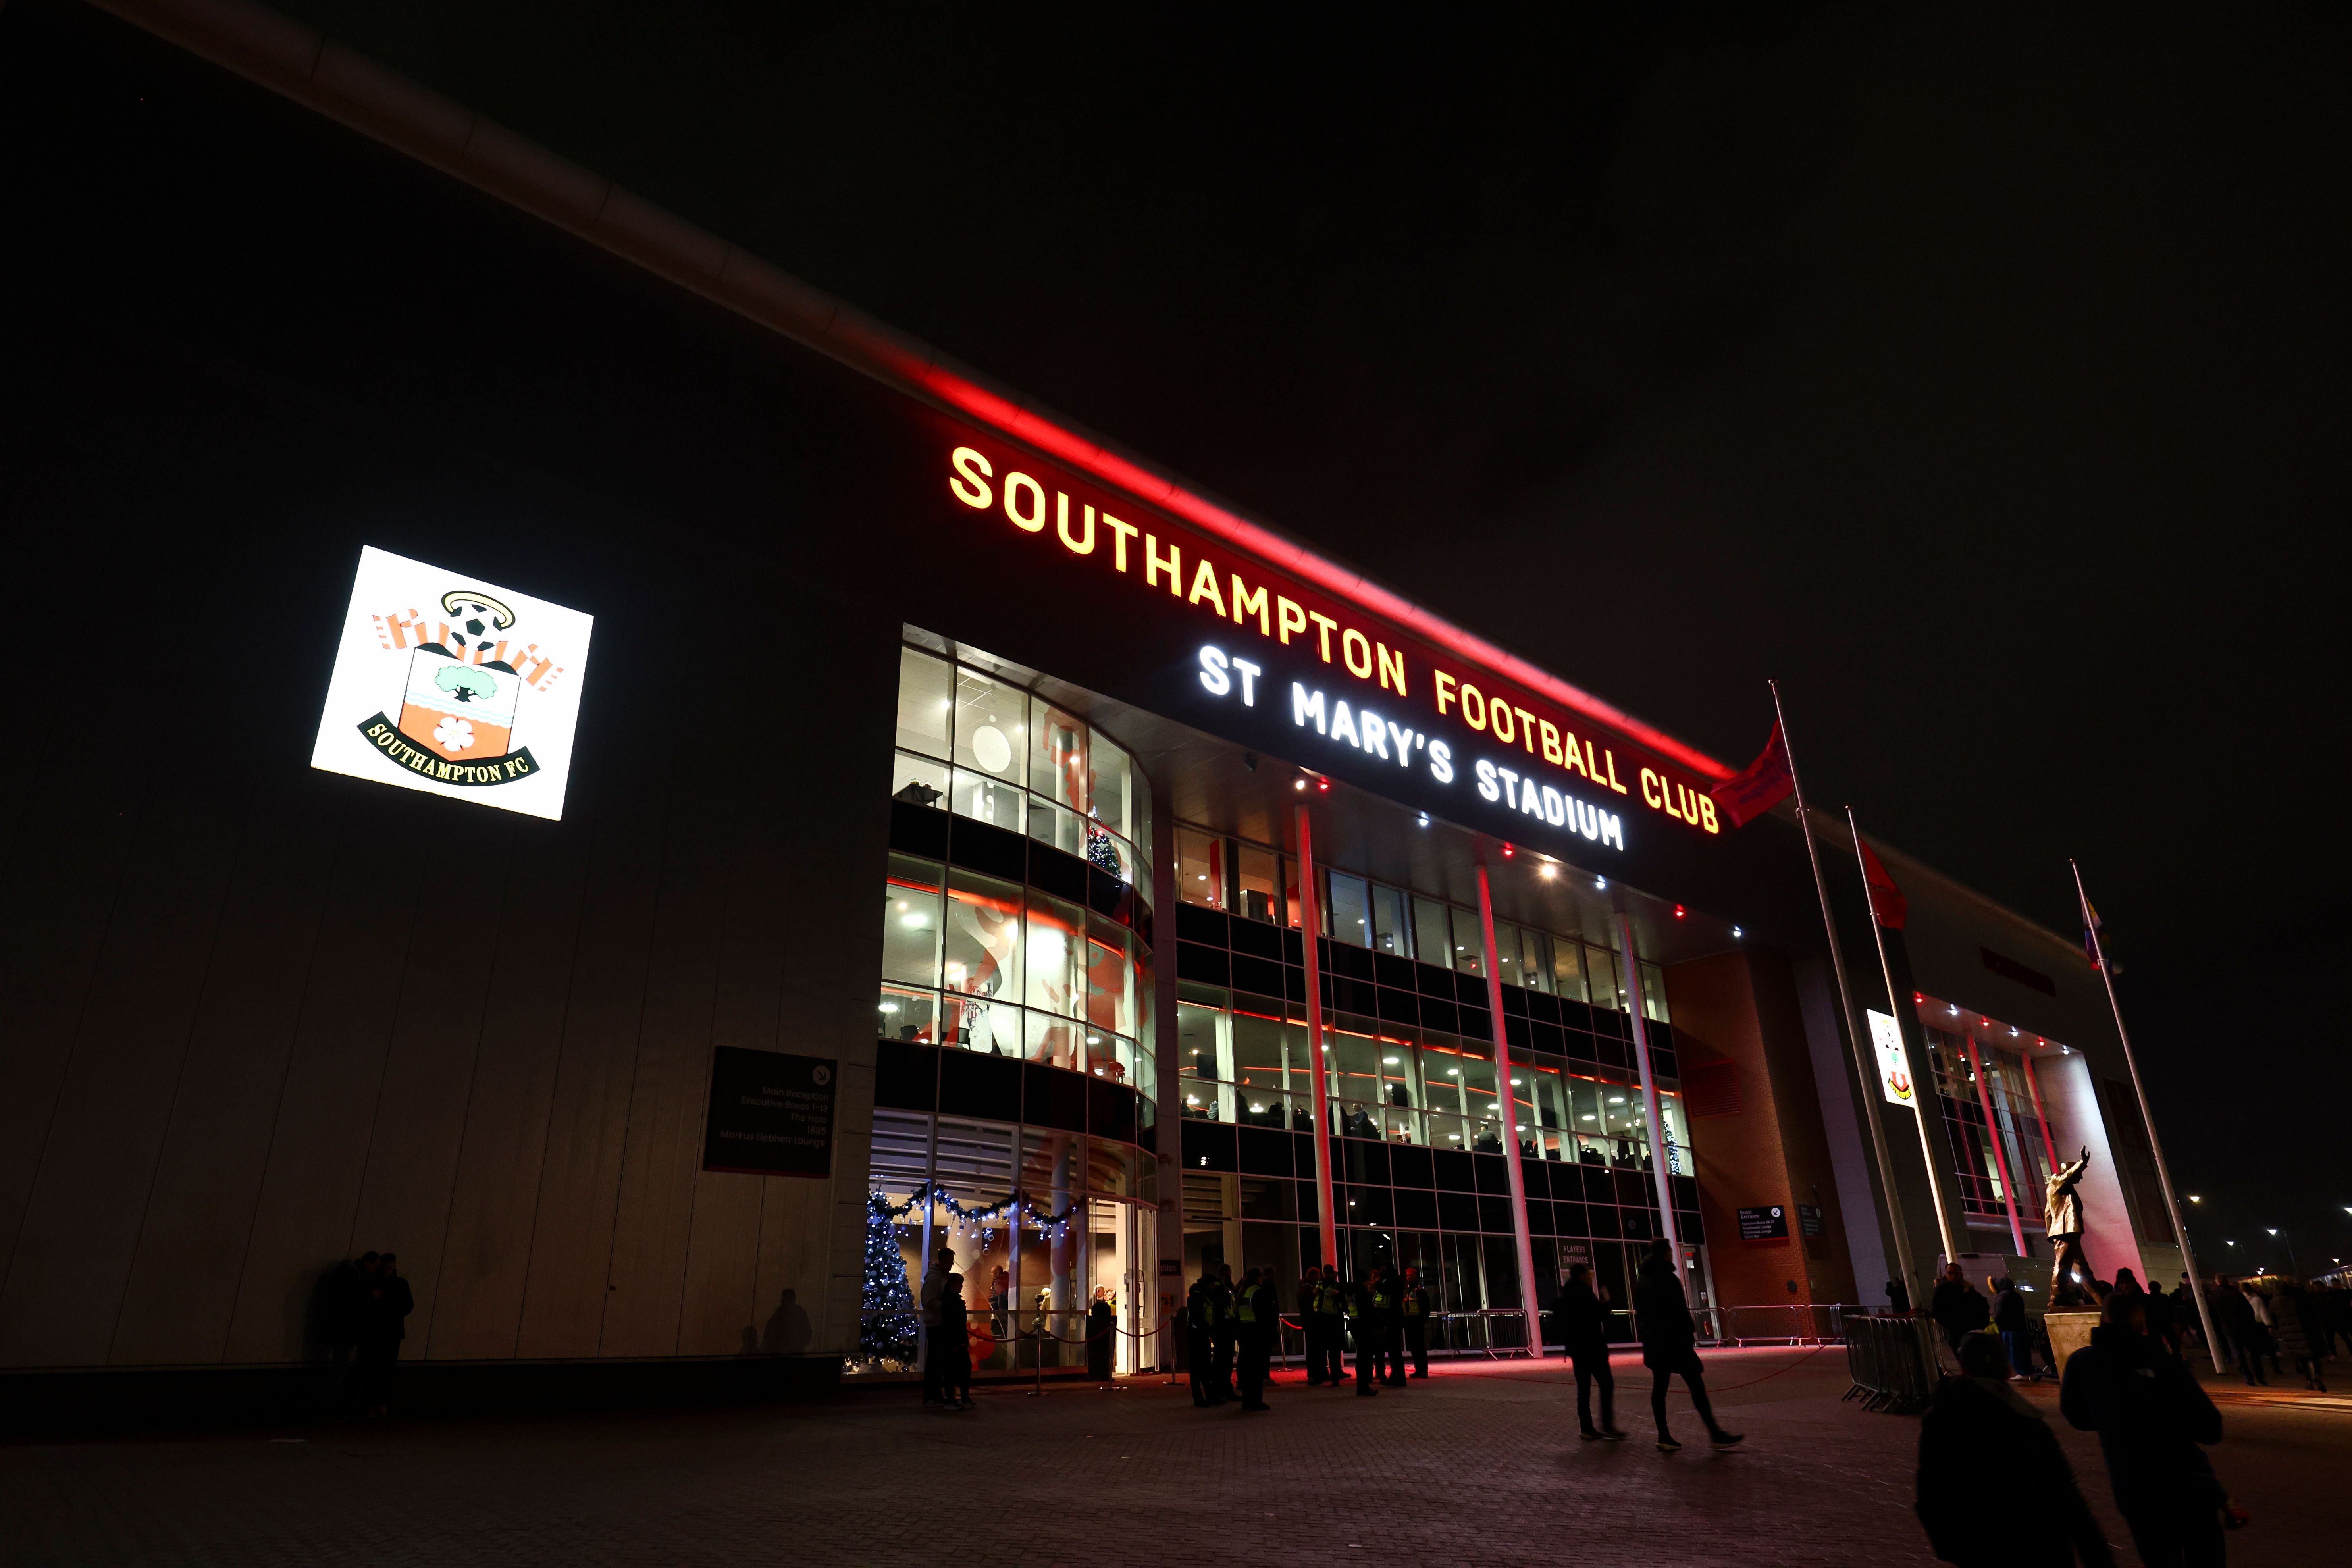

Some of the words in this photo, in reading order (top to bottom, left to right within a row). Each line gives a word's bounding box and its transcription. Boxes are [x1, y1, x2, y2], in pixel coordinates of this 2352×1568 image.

[950, 447, 1407, 697] SOUTHAMPTON
[1435, 669, 1627, 795] FOOTBALL
[1641, 768, 1719, 834] CLUB
[367, 724, 502, 782] SOUTHAMPTON
[503, 757, 528, 778] FC
[1199, 645, 1261, 707] ST
[1292, 682, 1454, 784] MARY'S
[1476, 759, 1624, 851] STADIUM
[762, 1086, 784, 1096] Main
[786, 1089, 829, 1101] Reception
[741, 1096, 782, 1108] Executive
[785, 1101, 809, 1111] Boxes
[791, 1113, 805, 1121] The
[808, 1115, 827, 1124] Halo
[720, 1130, 754, 1140] Markus
[794, 1137, 826, 1148] Lounge
